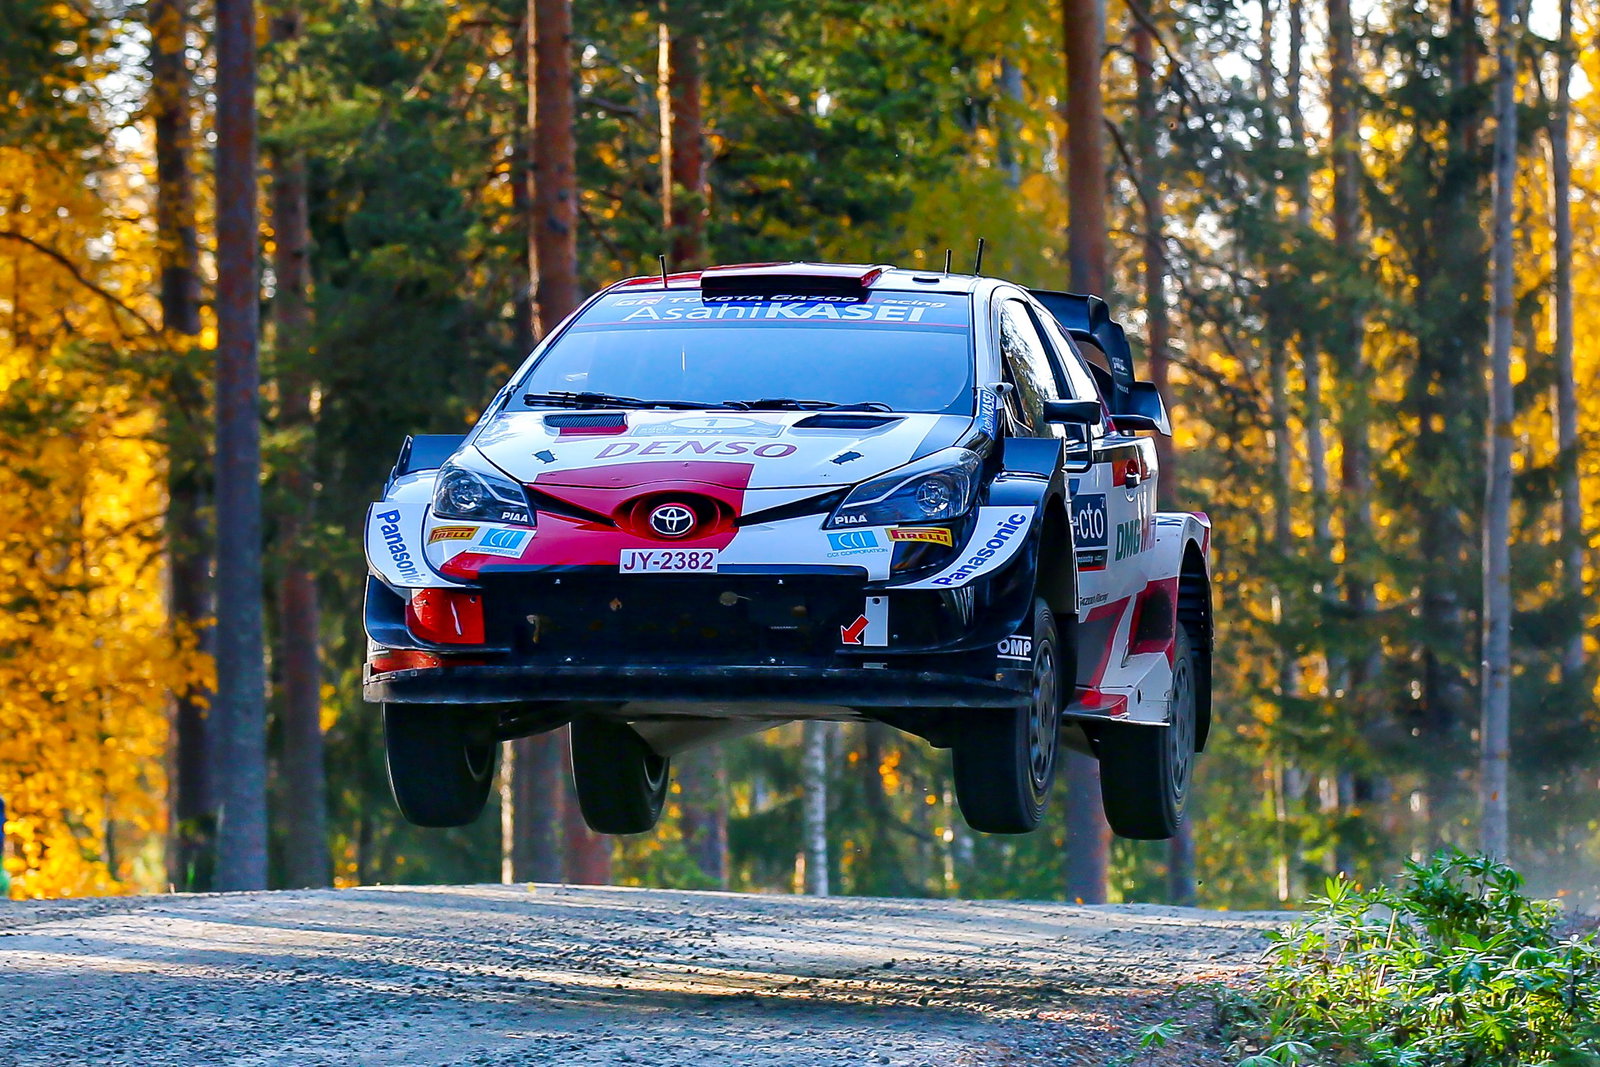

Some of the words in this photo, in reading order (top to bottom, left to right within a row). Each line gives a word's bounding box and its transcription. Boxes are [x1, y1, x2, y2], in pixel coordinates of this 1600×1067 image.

[668, 295, 763, 304] TOYOTA
[770, 294, 859, 303] GAZOO
[621, 301, 926, 322] AsahiKASEI
[704, 418, 718, 426] 1
[593, 440, 798, 460] DENSO
[501, 511, 529, 523] PIAA
[834, 515, 868, 525] PIAA
[1072, 502, 1104, 539] ecto
[430, 527, 476, 543] PIRELLI
[890, 529, 949, 542] PIRELLI
[376, 508, 424, 584] Panasonic
[930, 513, 1027, 586] Panasonic
[623, 551, 714, 571] JY-2382
[997, 639, 1031, 656] OMP
